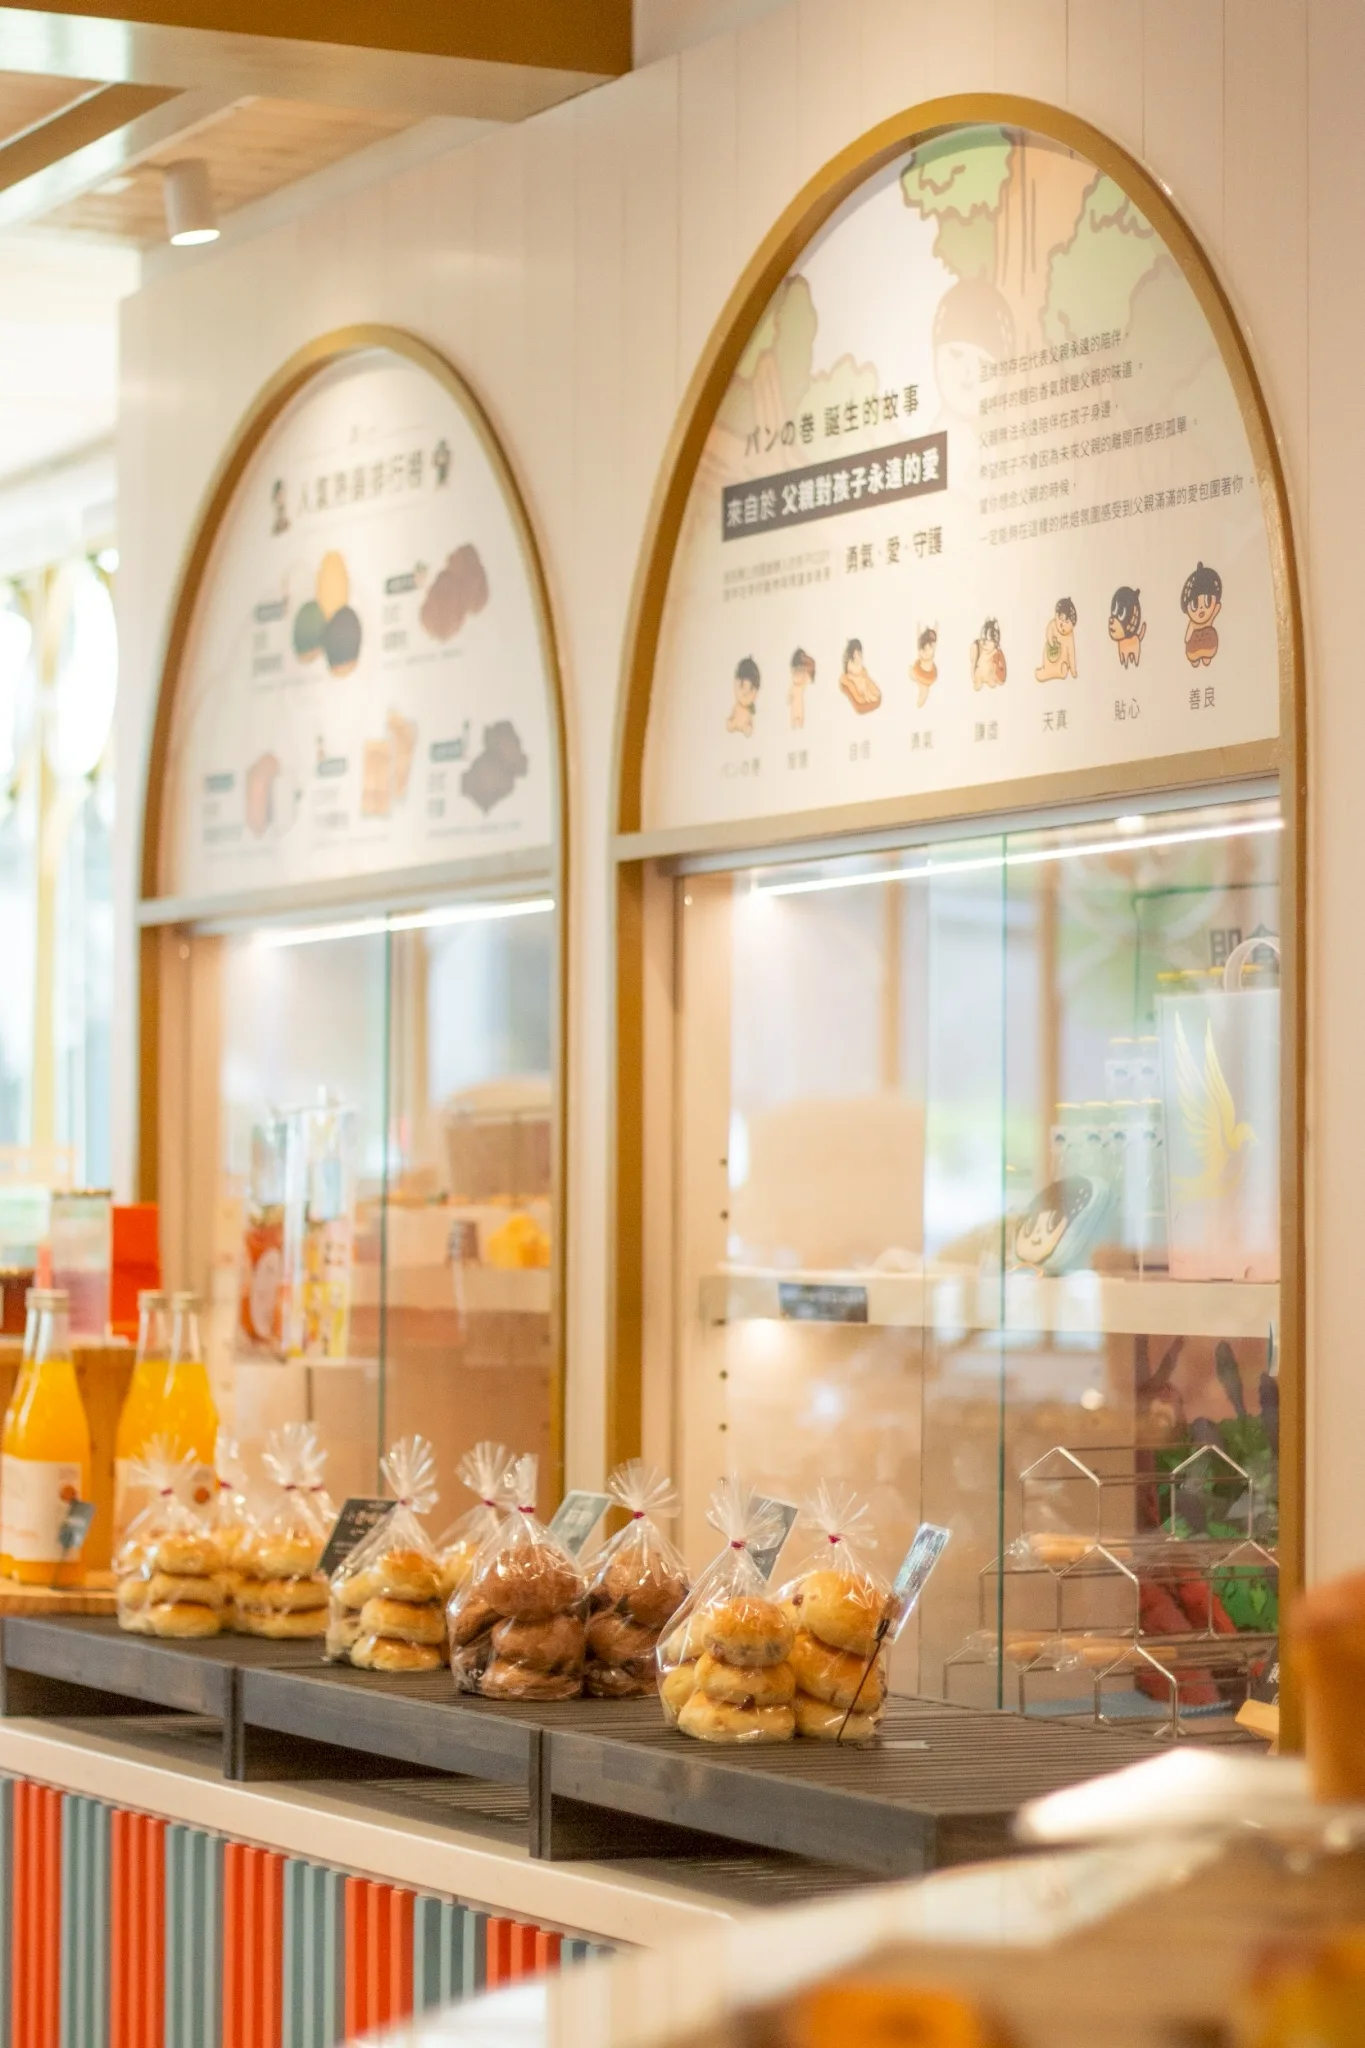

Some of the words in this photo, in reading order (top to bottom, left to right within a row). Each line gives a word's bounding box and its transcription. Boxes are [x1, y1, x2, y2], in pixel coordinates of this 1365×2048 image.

[825, 384, 919, 438] 誕生的故事
[781, 447, 939, 516] 父親對孩子永遠的愛
[1114, 698, 1141, 721] 貼心
[1188, 685, 1216, 711] 善良
[1042, 709, 1068, 733] 天真
